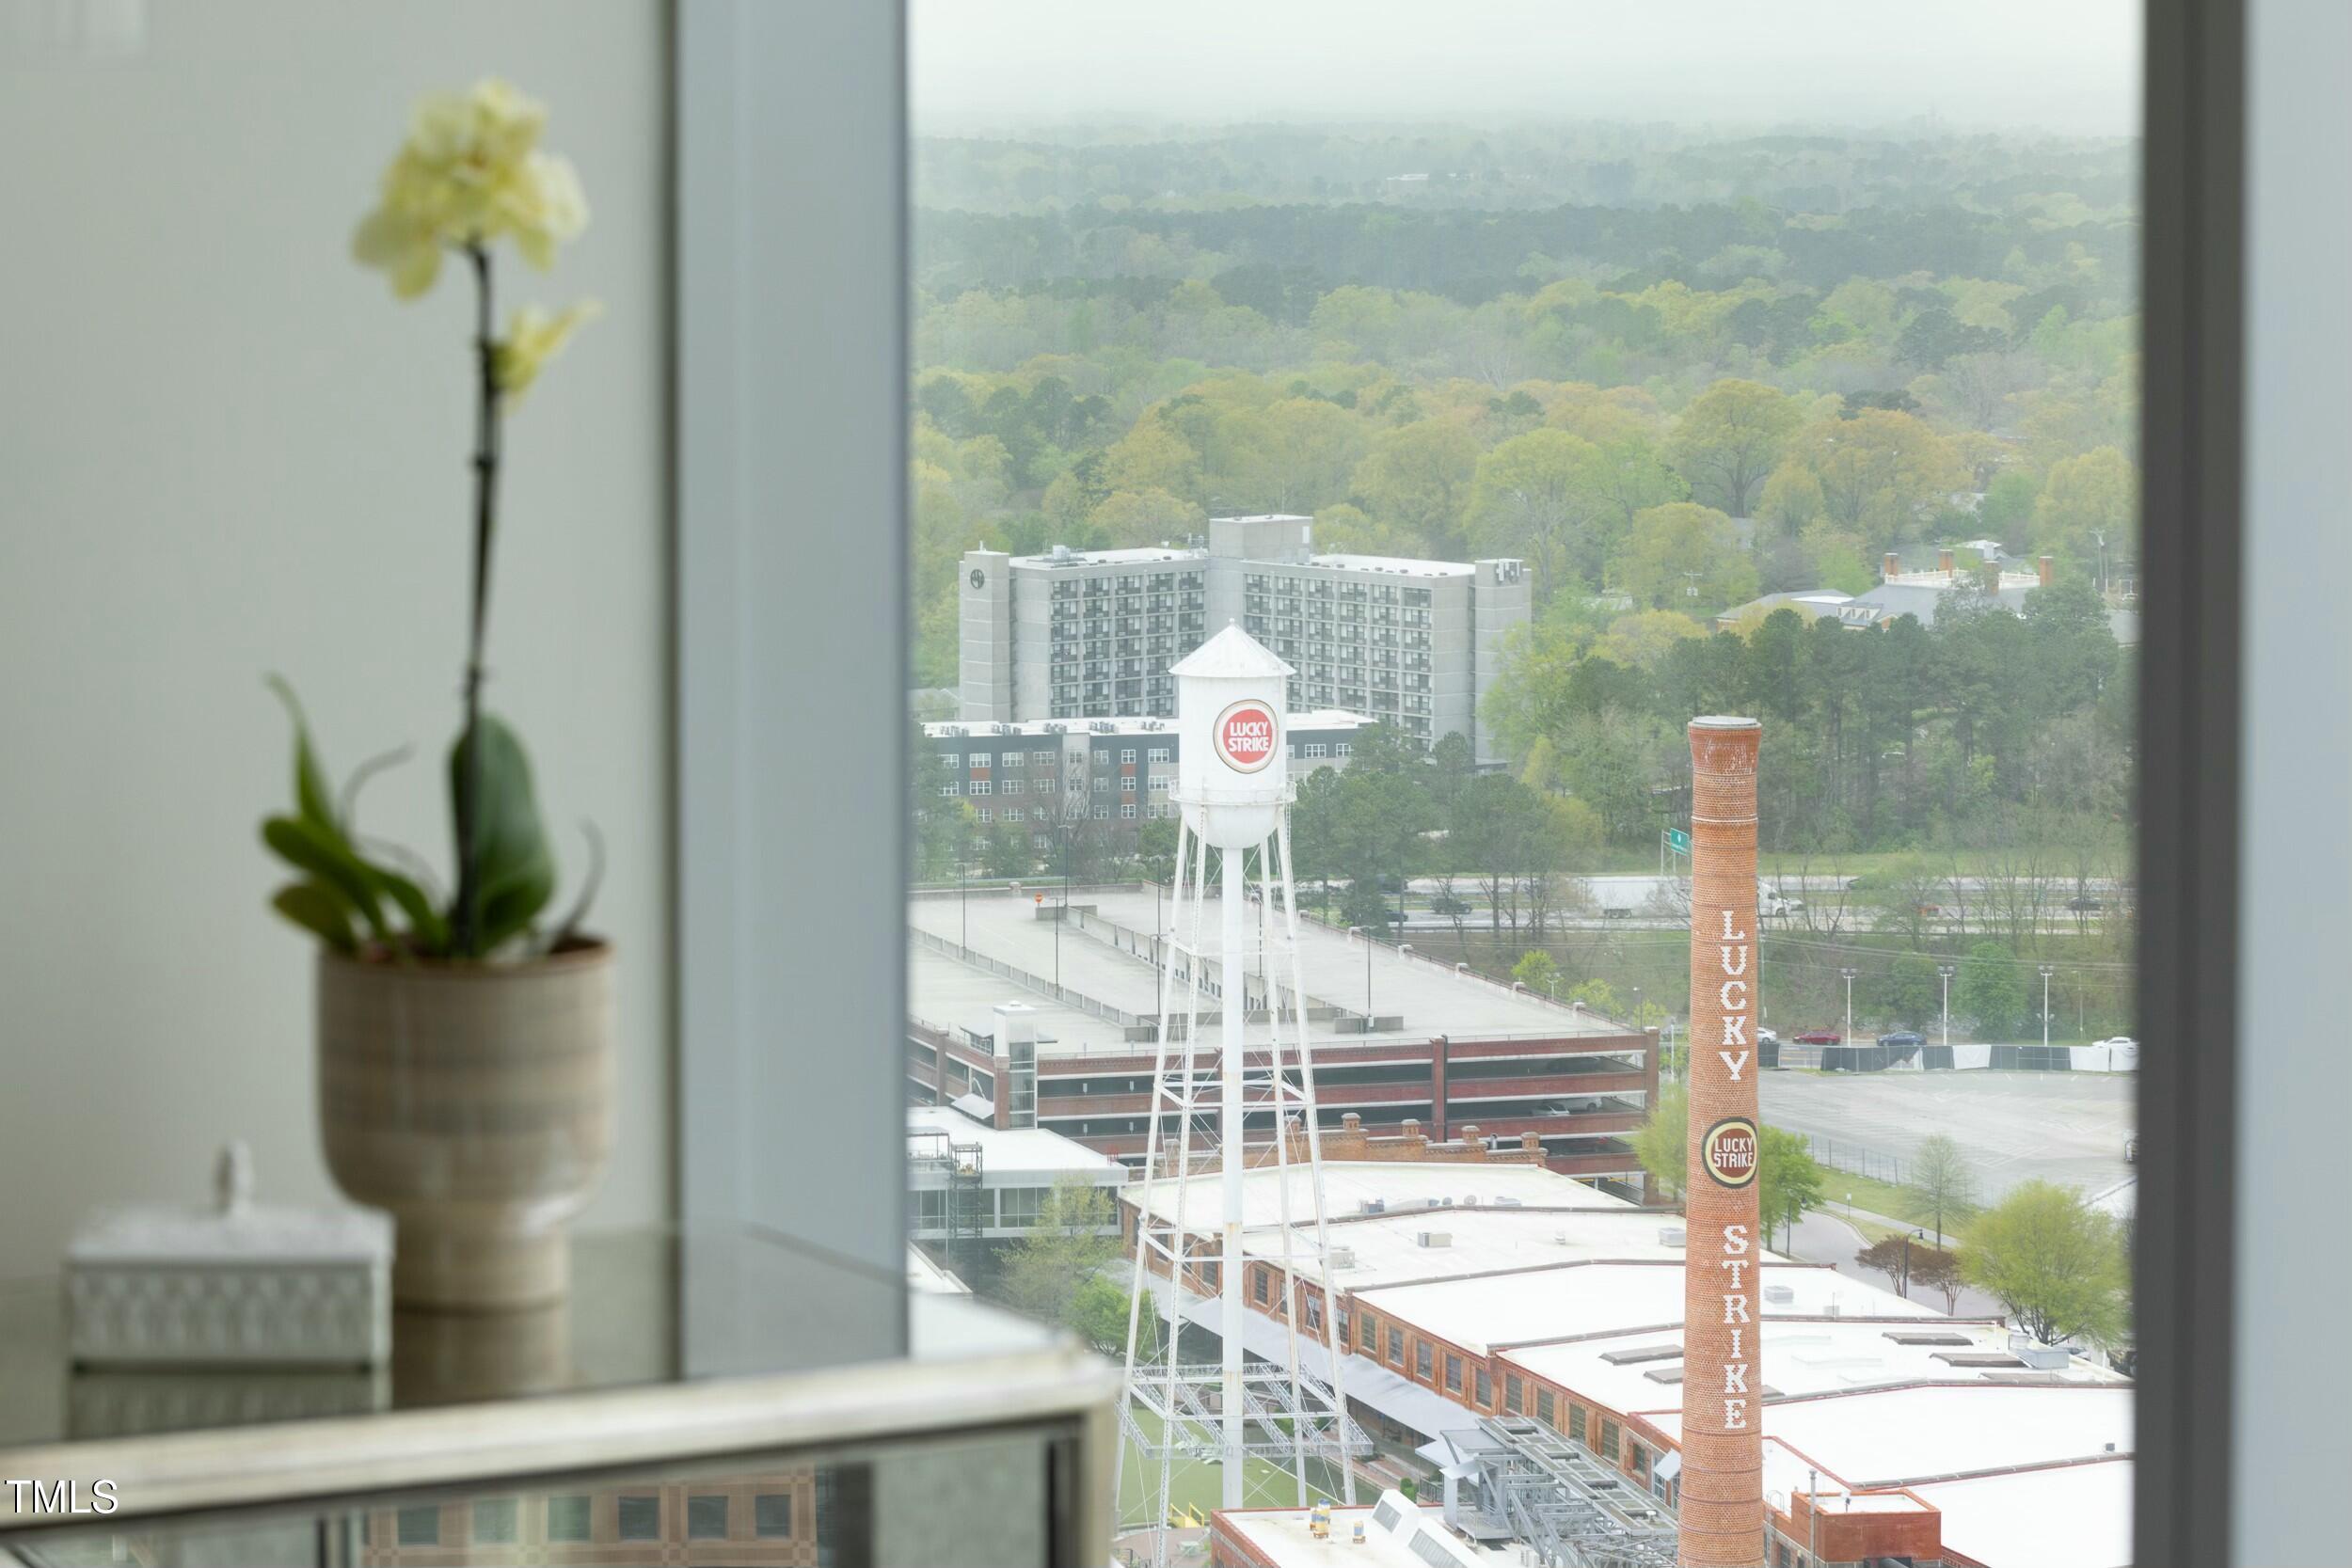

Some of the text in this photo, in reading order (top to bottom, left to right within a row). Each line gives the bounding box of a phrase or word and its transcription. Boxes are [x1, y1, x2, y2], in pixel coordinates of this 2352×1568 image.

[1230, 721, 1268, 736] LUCKY
[1228, 736, 1269, 752] STRIKE
[1719, 910, 1750, 1081] LUCKY
[1714, 1137, 1753, 1152] LUCKY
[1713, 1152, 1753, 1167] STRIKE
[1722, 1225, 1751, 1429] STRIKE
